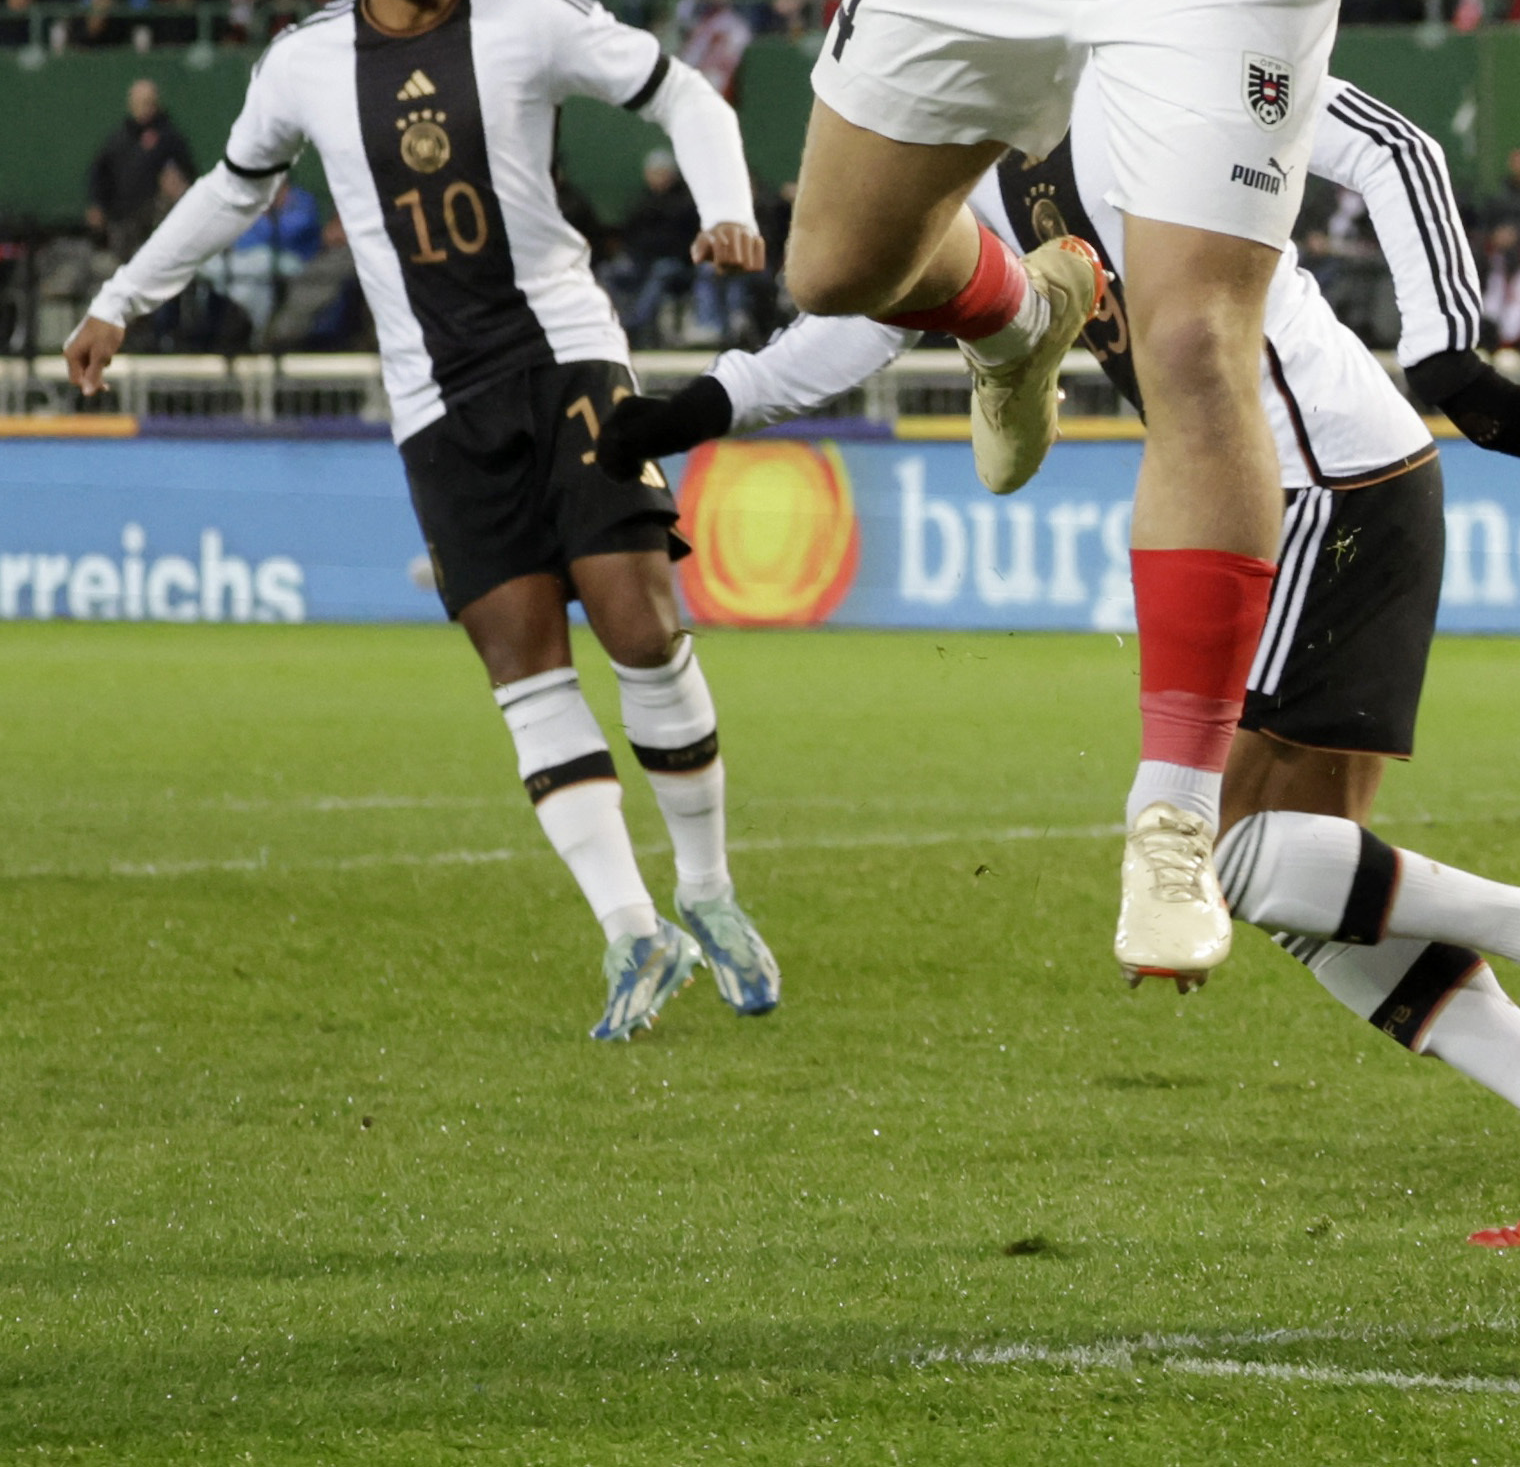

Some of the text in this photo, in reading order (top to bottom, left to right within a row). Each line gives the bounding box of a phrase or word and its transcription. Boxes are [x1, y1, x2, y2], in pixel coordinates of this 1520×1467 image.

[1230, 163, 1281, 196] PUMA
[394, 181, 488, 264] 10
[565, 385, 633, 465] 1
[0, 521, 307, 623] rreichs
